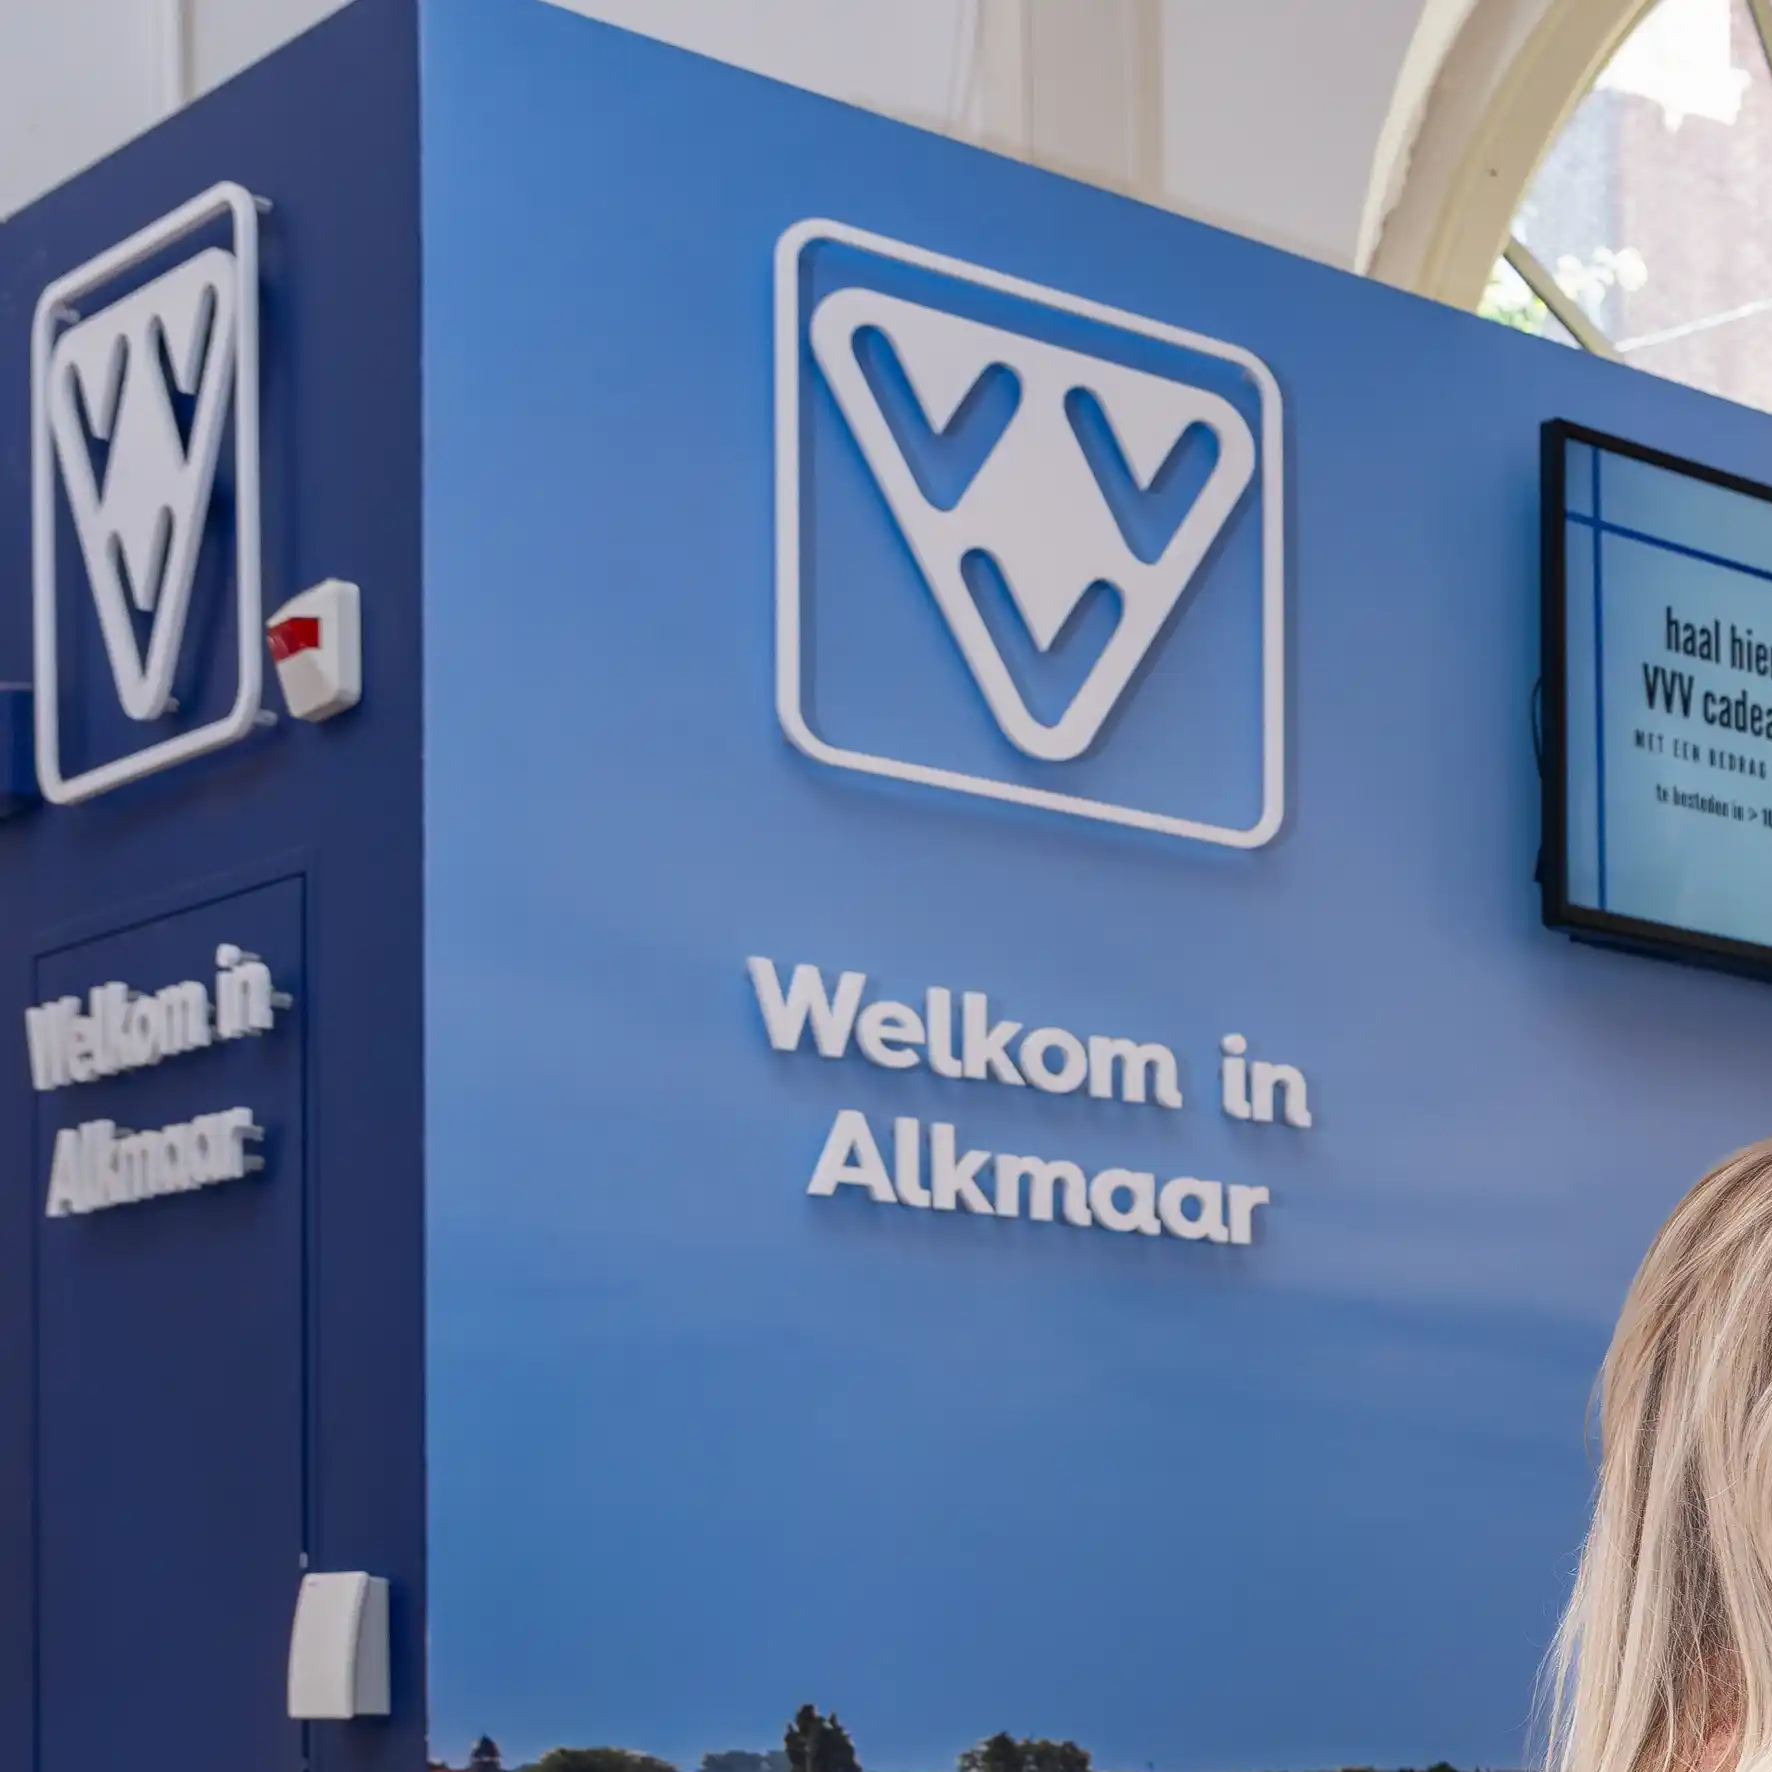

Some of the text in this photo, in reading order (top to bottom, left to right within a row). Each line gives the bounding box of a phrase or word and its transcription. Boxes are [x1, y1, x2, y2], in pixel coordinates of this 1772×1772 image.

[1666, 606, 1720, 664] haal
[1642, 662, 1694, 718] VVV
[1634, 729, 1664, 752] MET
[1673, 739, 1701, 762] EEN
[1709, 749, 1767, 779] BEDRAG
[1656, 784, 1668, 801] te
[1673, 787, 1729, 817] besteden
[1732, 803, 1744, 820] in
[25, 943, 273, 1090] Welkom in
[746, 956, 1312, 1128] Welkom in
[46, 1106, 254, 1218] Alkmaar
[806, 1109, 1270, 1245] Alkmaar
